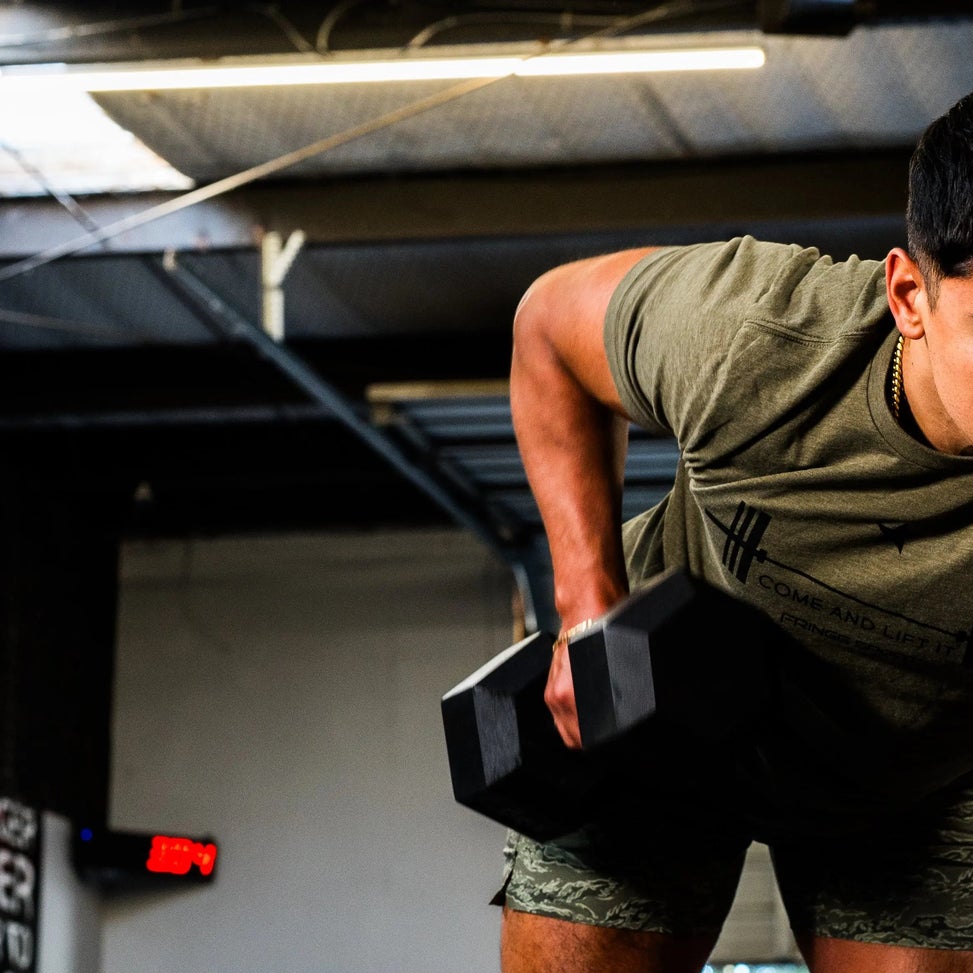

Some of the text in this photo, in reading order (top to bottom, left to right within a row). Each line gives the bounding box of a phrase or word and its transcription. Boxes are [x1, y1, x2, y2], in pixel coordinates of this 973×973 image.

[758, 575, 958, 657] COME AND LIFT IT
